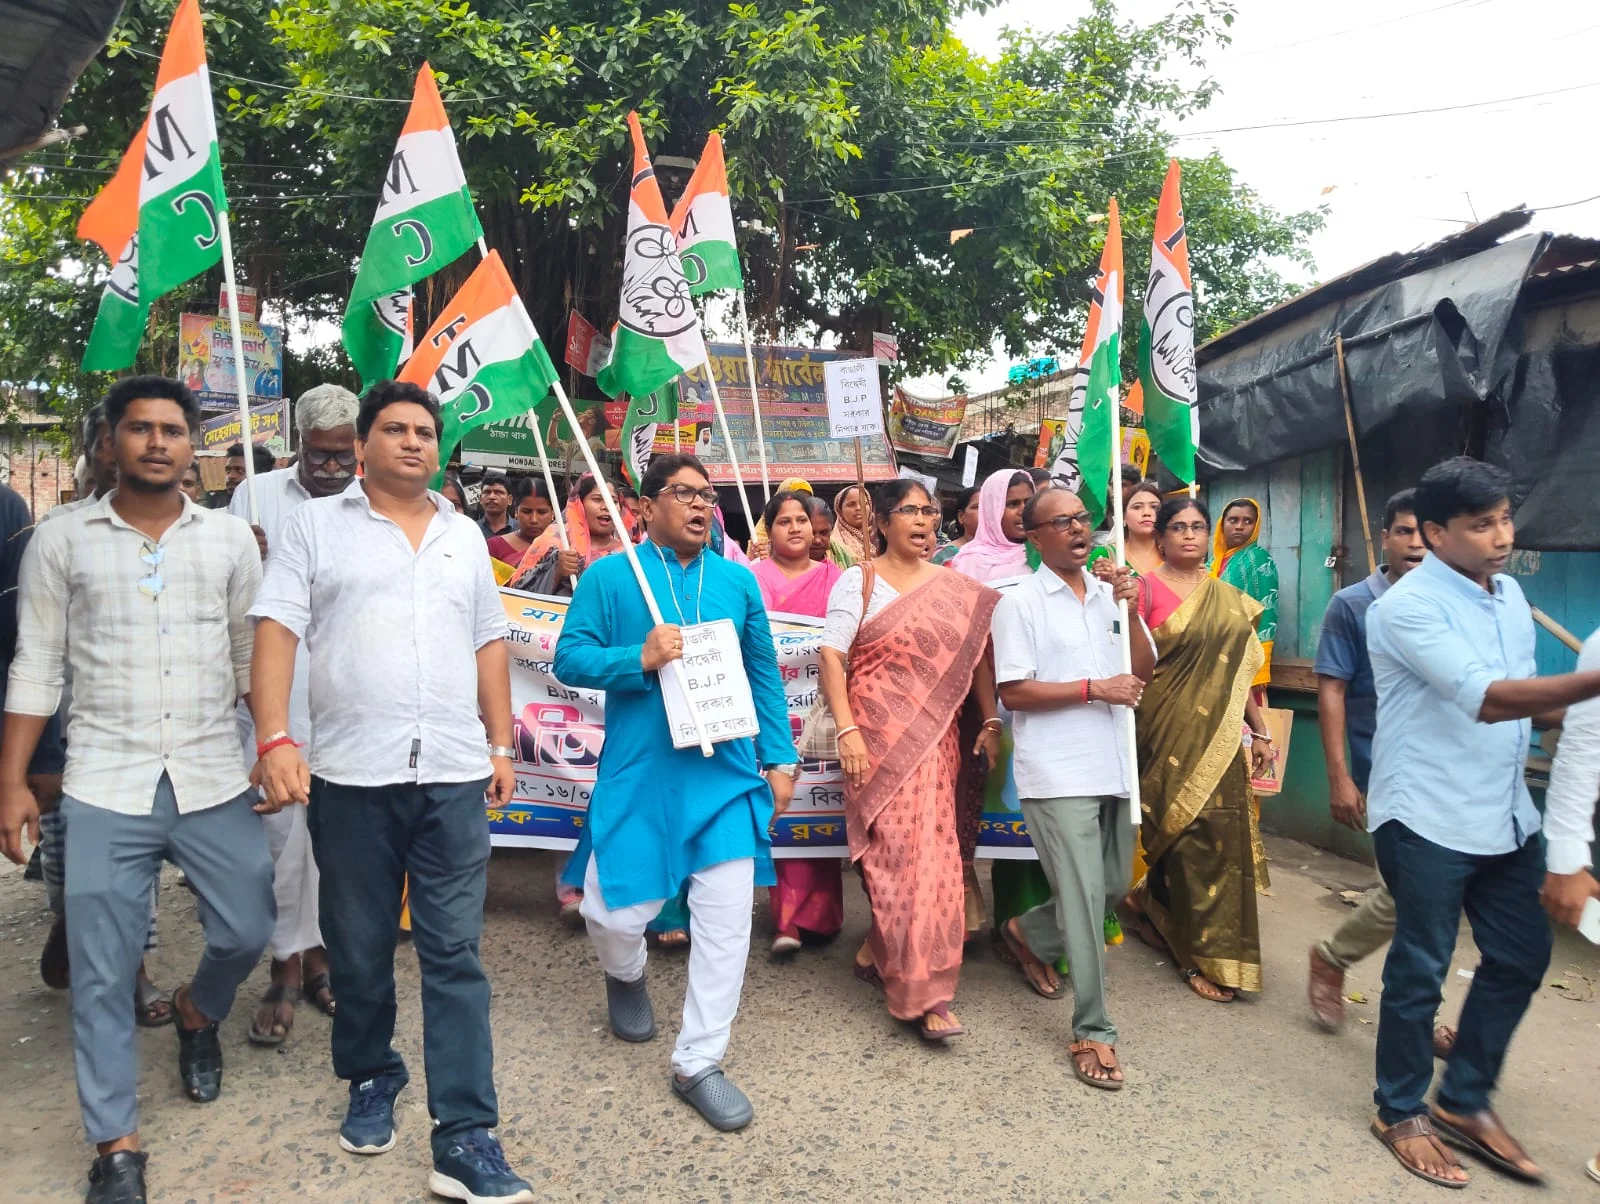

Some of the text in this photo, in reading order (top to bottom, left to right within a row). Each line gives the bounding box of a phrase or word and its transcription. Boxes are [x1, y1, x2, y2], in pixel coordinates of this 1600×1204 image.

[508, 457, 537, 467] MONDAL
[688, 674, 726, 691] B.J.P
[546, 685, 580, 702] BJP
